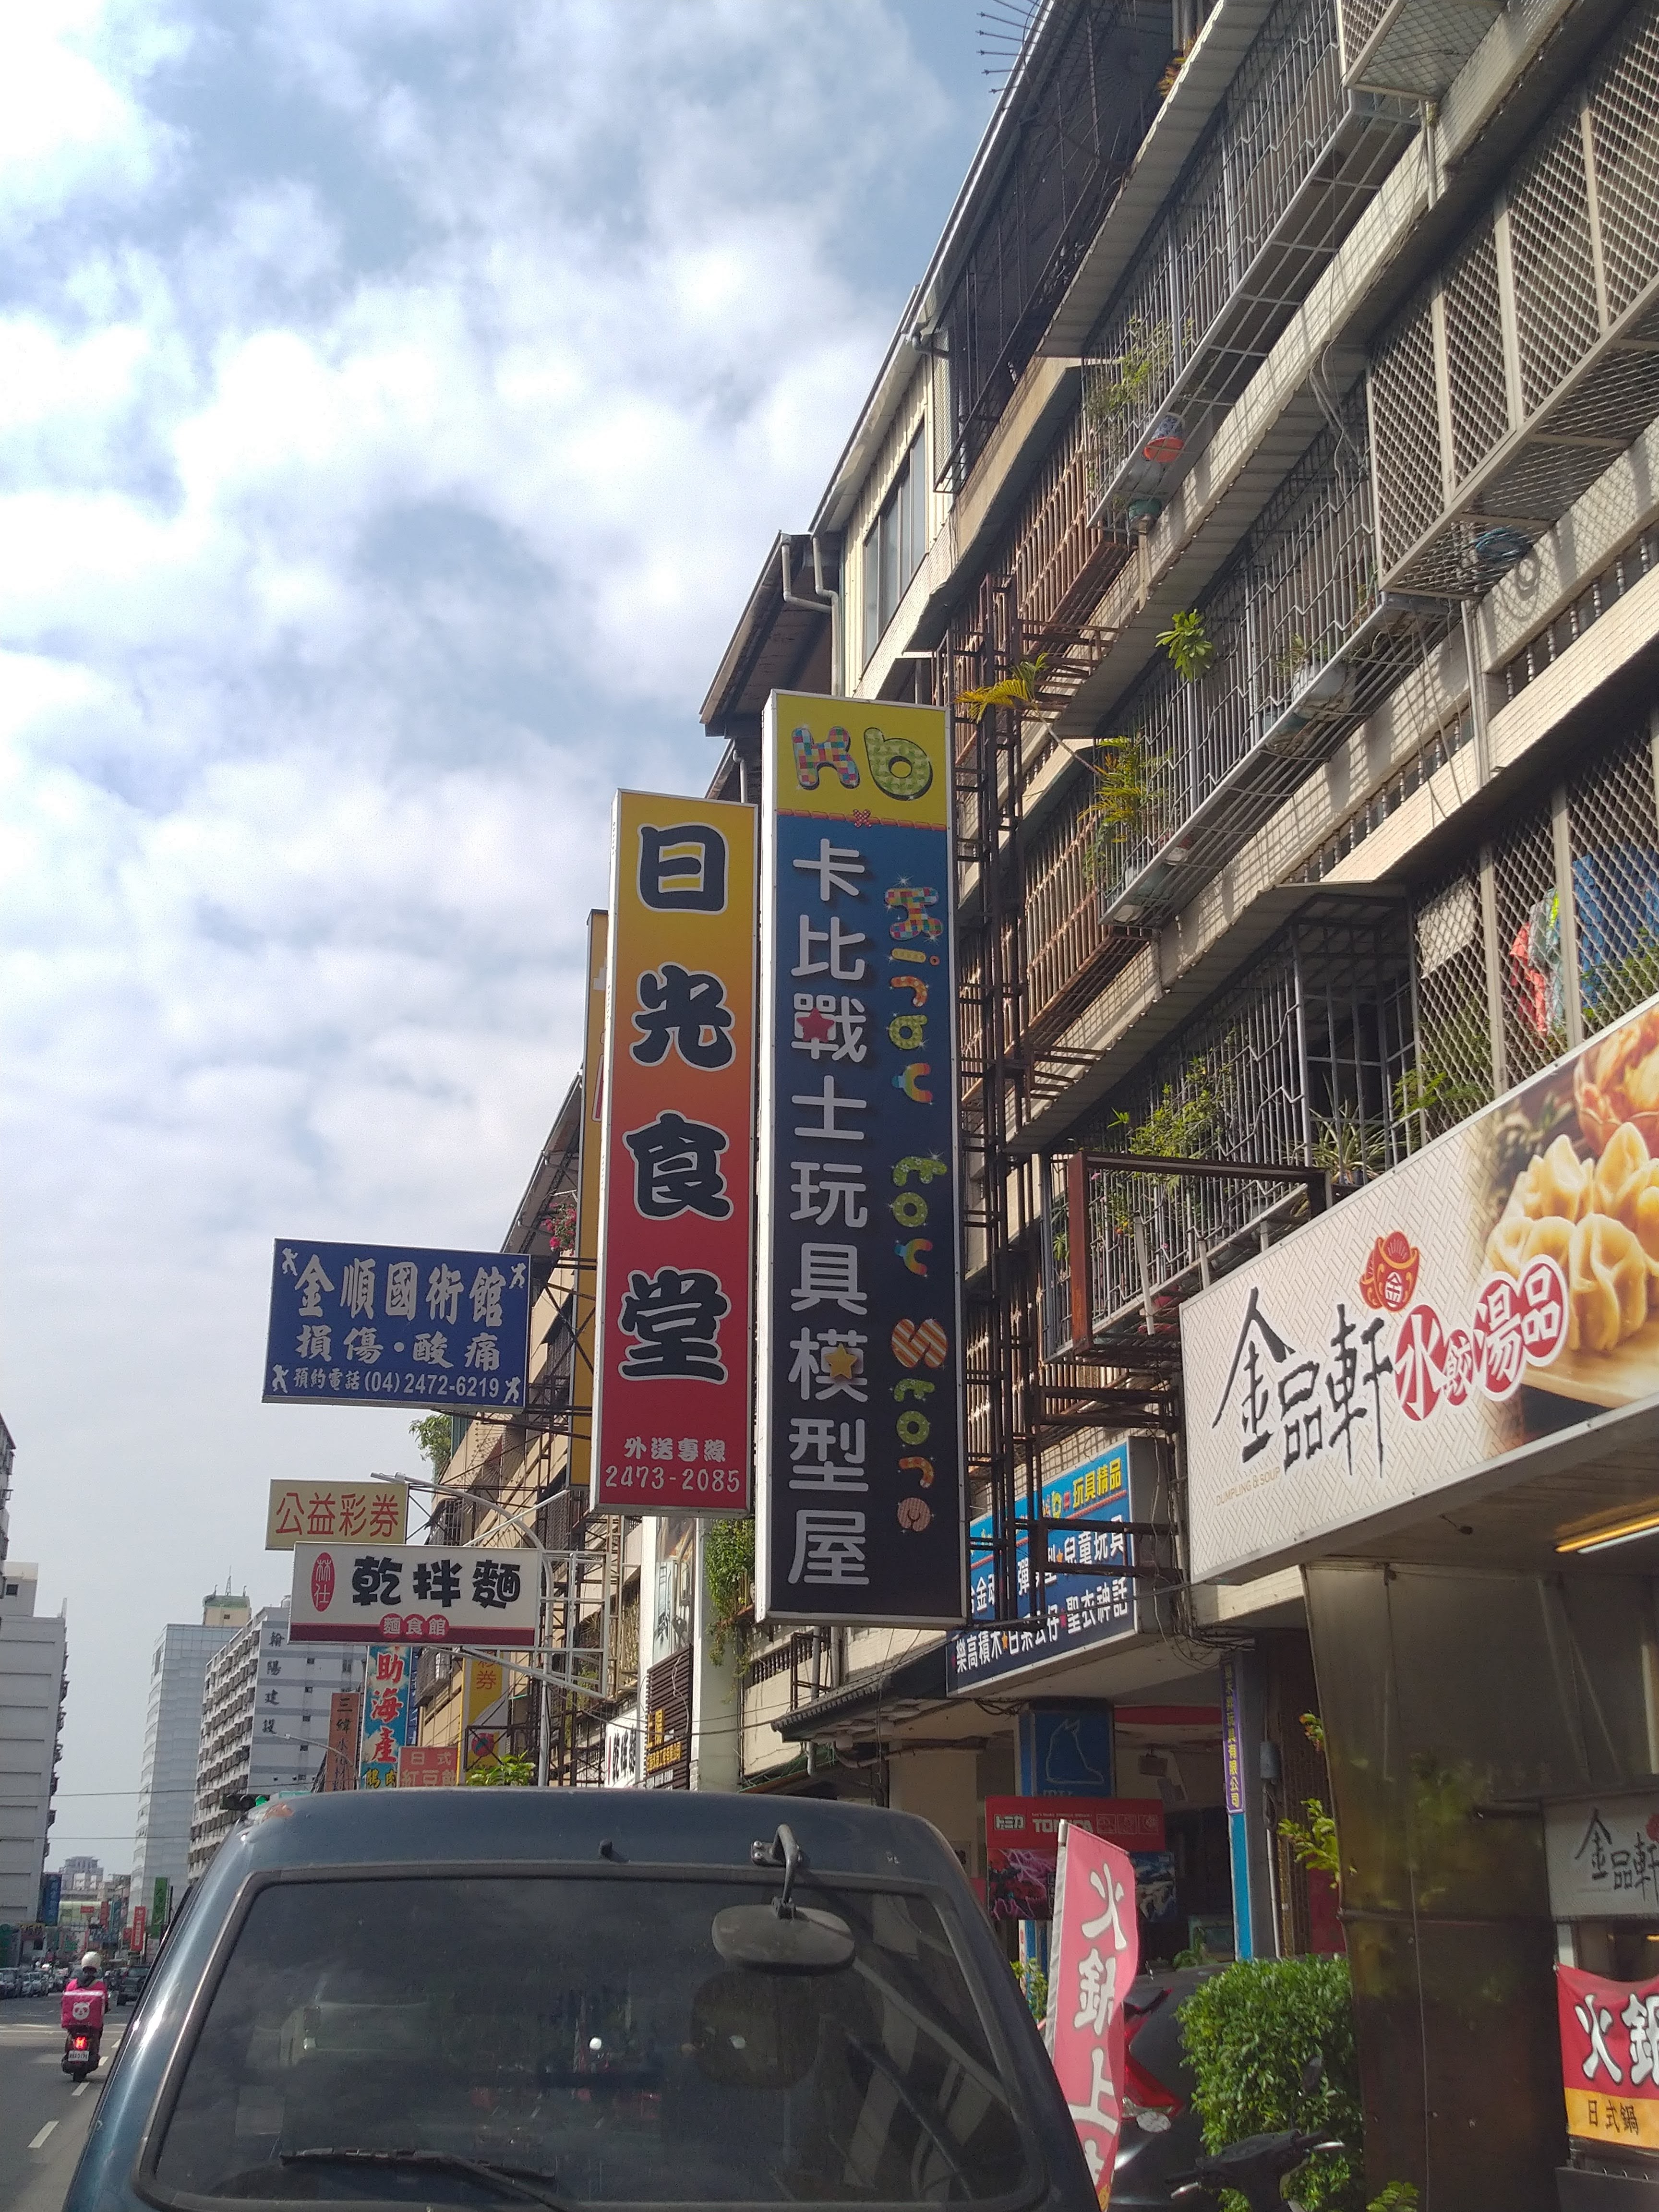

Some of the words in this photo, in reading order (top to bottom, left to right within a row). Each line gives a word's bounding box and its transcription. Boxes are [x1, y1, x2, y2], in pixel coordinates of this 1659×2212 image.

[617, 821, 735, 1385] 日光食堂
[294, 1253, 507, 1328] 金順國術館
[1395, 1261, 1560, 1420] 水餃湯品
[293, 1367, 360, 1391] 預約電話
[1211, 1286, 1394, 1479] 金品軒
[624, 1436, 725, 1463] 外送專線
[605, 1465, 740, 1492] 2473-2085
[1072, 1457, 1122, 1509] 玩具精品
[1216, 1479, 1252, 1506] DUMPLING
[1253, 1474, 1259, 1489] &
[1260, 1466, 1281, 1486] SOUP
[276, 1491, 399, 1537] 公益彩券
[351, 1555, 521, 1609] 乾拌麵
[384, 1617, 446, 1636] 麵食館
[368, 1646, 404, 1764] 助海產
[1575, 1807, 1659, 1906] 金品軒
[1587, 2099, 1639, 2136] 日式鍋
